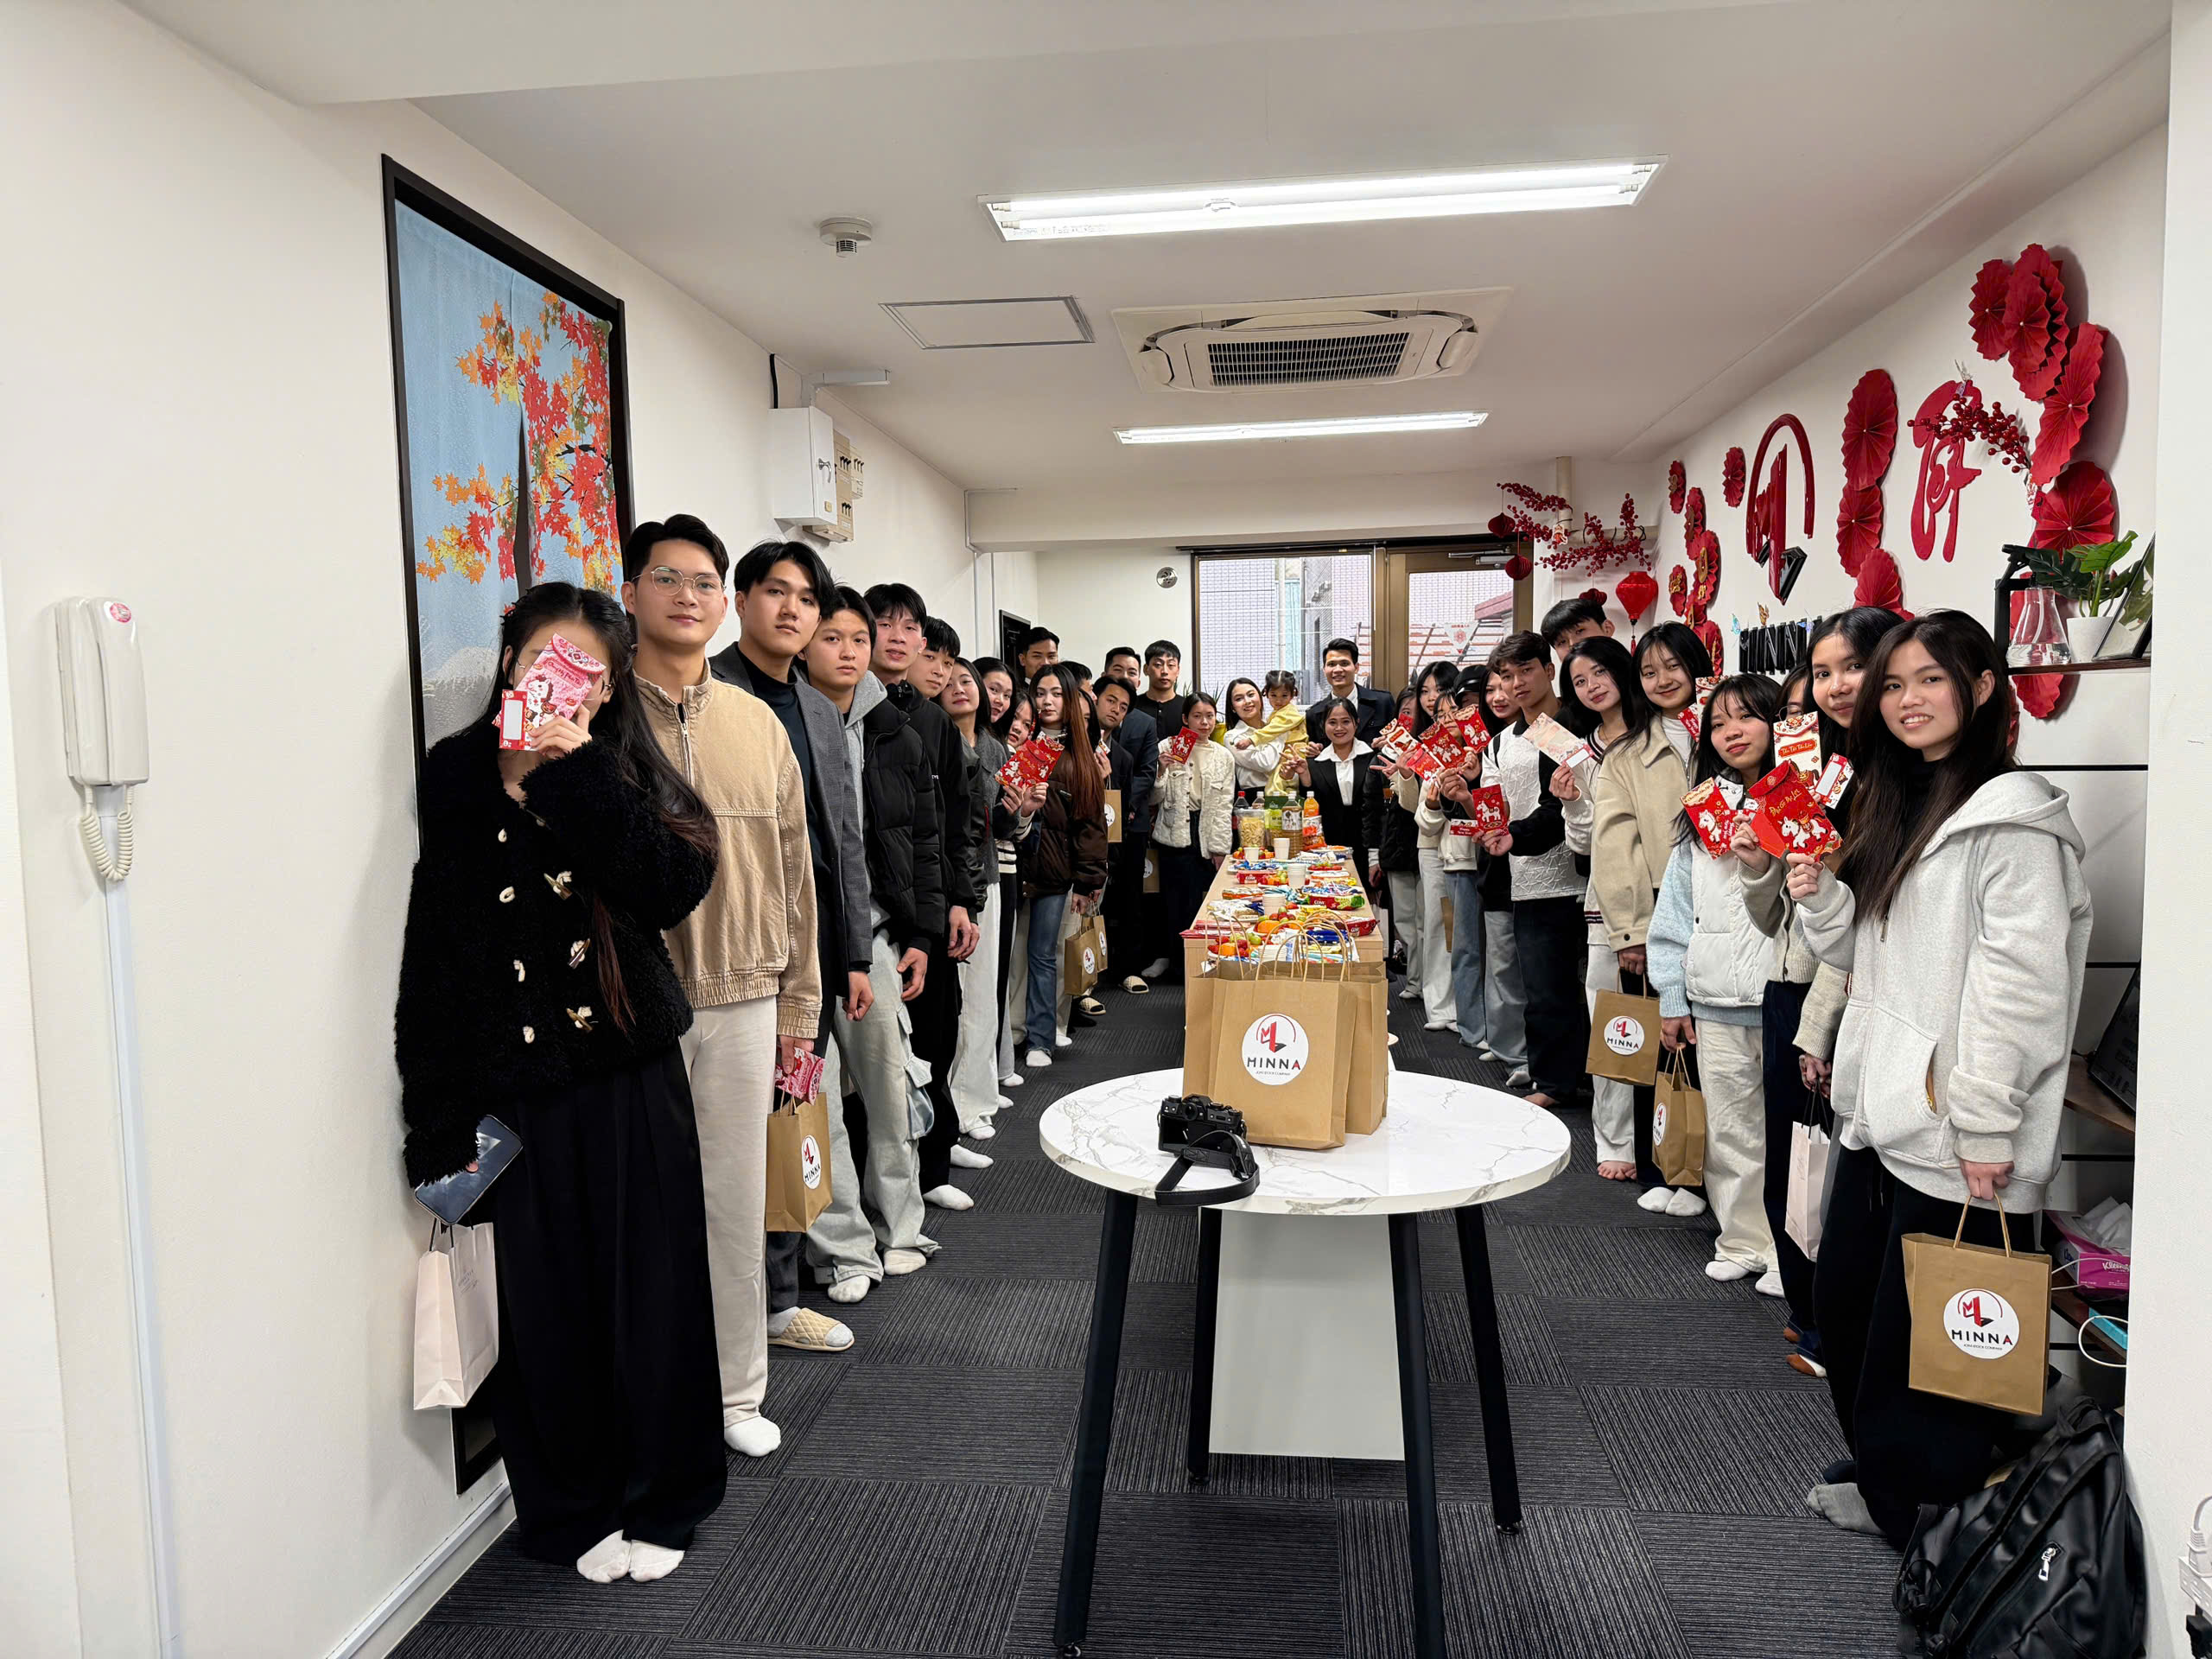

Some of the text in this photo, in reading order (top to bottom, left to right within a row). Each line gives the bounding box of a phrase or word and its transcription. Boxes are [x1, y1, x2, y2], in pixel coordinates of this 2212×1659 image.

[1607, 1037, 1639, 1049] MINNA
[1247, 1057, 1301, 1071] MINNA
[1951, 1329, 2013, 1346] MINNA
